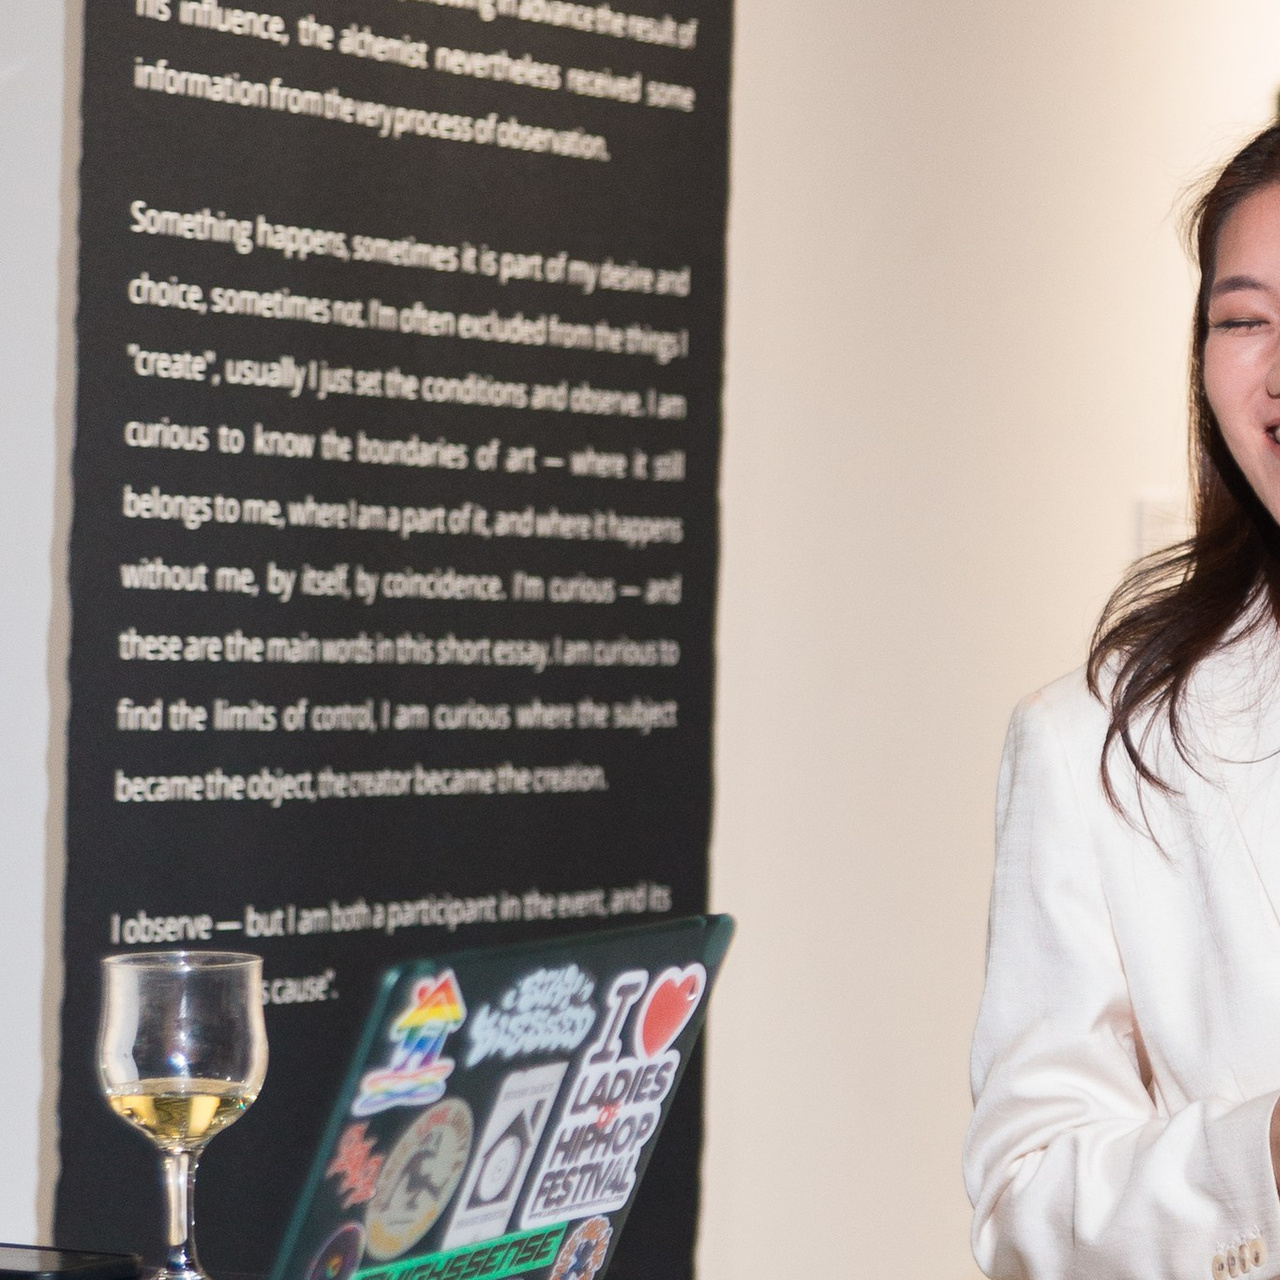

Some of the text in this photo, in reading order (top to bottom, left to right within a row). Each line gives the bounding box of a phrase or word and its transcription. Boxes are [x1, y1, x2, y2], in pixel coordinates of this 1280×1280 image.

[296, 14, 334, 50] the
[337, 23, 429, 69] alchemist
[133, 56, 498, 144] information from process of
[129, 199, 543, 284] Something happens, sometimes part
[127, 271, 332, 324] choice, sometimes
[224, 355, 307, 398] usually
[316, 360, 354, 400] just
[419, 372, 529, 409] conditions
[123, 416, 536, 473] curious to know boundaries of art
[121, 484, 447, 539] belongs to me, part
[119, 556, 297, 603] without me, by
[117, 626, 265, 663] these are the
[115, 696, 308, 732] find the limits of
[113, 769, 205, 803] became
[203, 767, 246, 801] the
[110, 904, 285, 944] I observe but
[589, 981, 642, 1065] I
[569, 1061, 674, 1116] LADIES
[549, 1112, 655, 1165] HIPHOP
[530, 1156, 636, 1212] FESTIVAL
